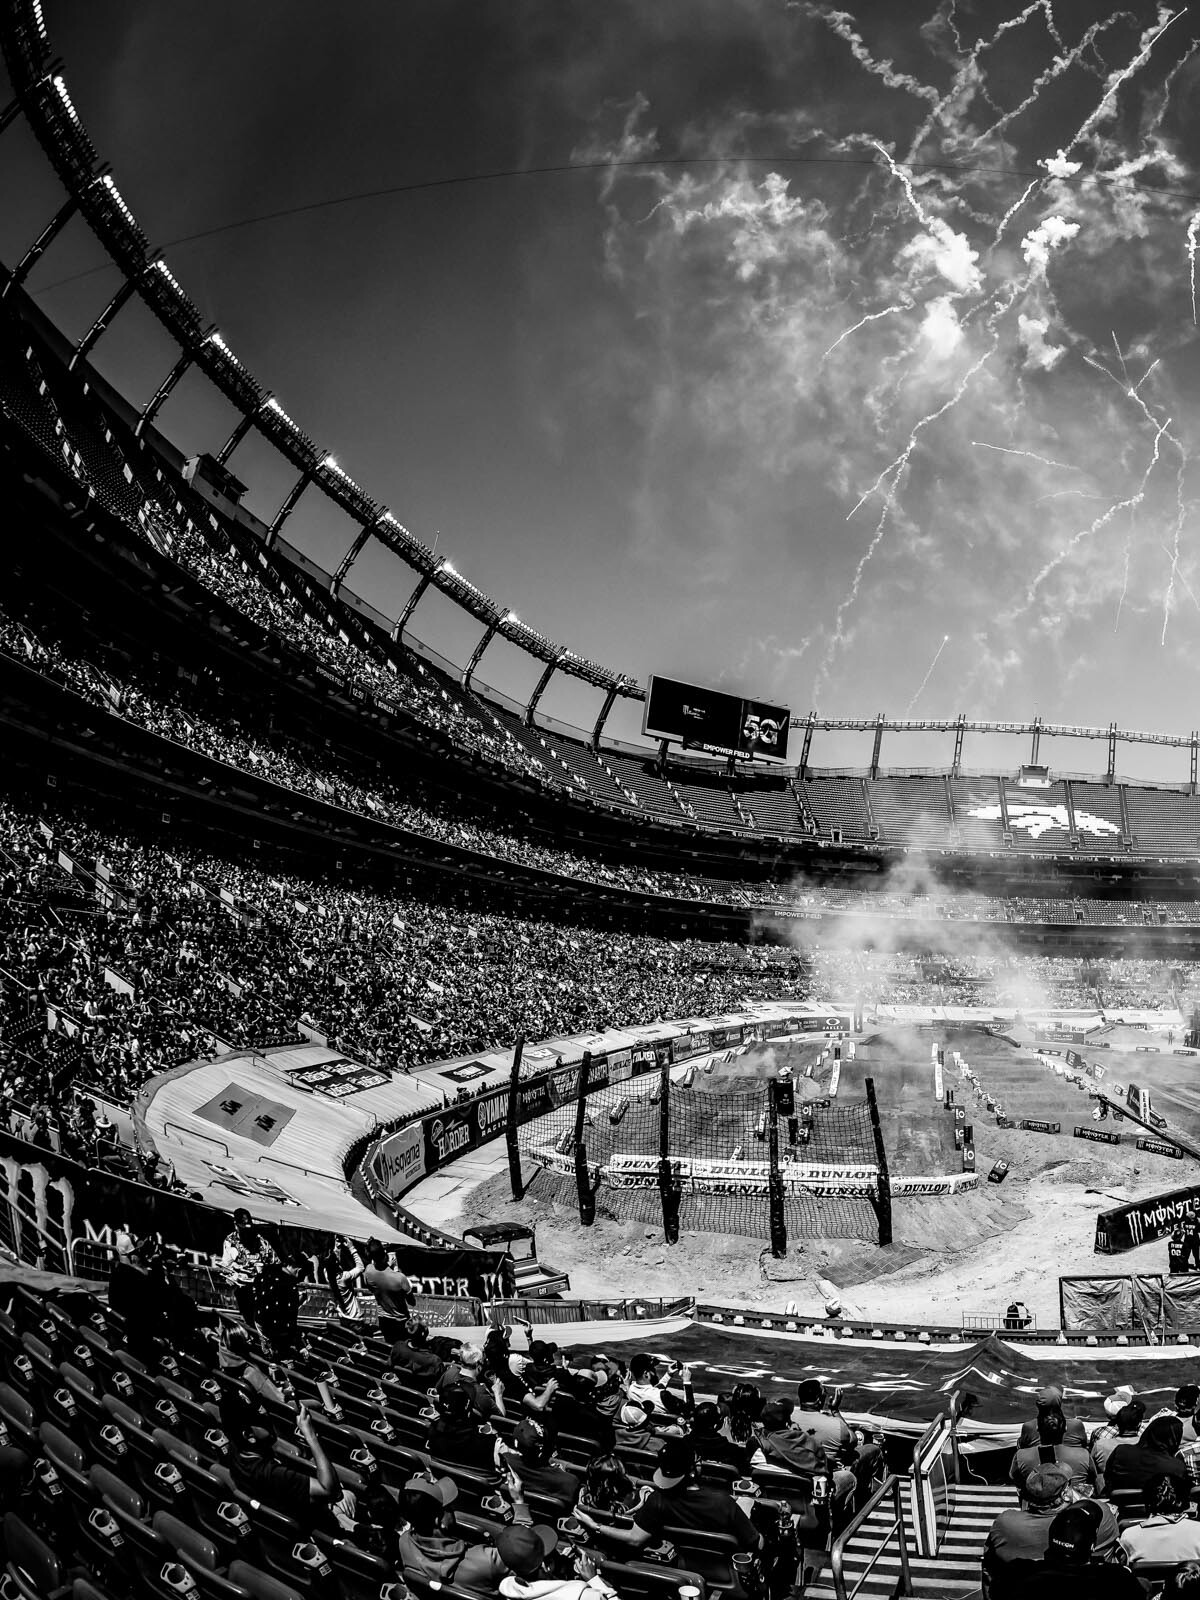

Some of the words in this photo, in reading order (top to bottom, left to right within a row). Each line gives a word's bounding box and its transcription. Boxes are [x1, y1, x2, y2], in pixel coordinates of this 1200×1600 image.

[703, 743, 733, 755] EMPOWER
[733, 749, 750, 759] FIELD
[774, 910, 804, 918] EMPOWER
[485, 1092, 511, 1121] YAMAH
[481, 1120, 508, 1137] RACIN
[1082, 1130, 1109, 1140] MONSTER
[438, 1124, 470, 1160] HARDER
[1145, 1143, 1174, 1154] MONSTER
[808, 1170, 877, 1179] DUNLOP
[903, 1183, 948, 1193] DUNLOP
[538, 1287, 547, 1295] CAT
